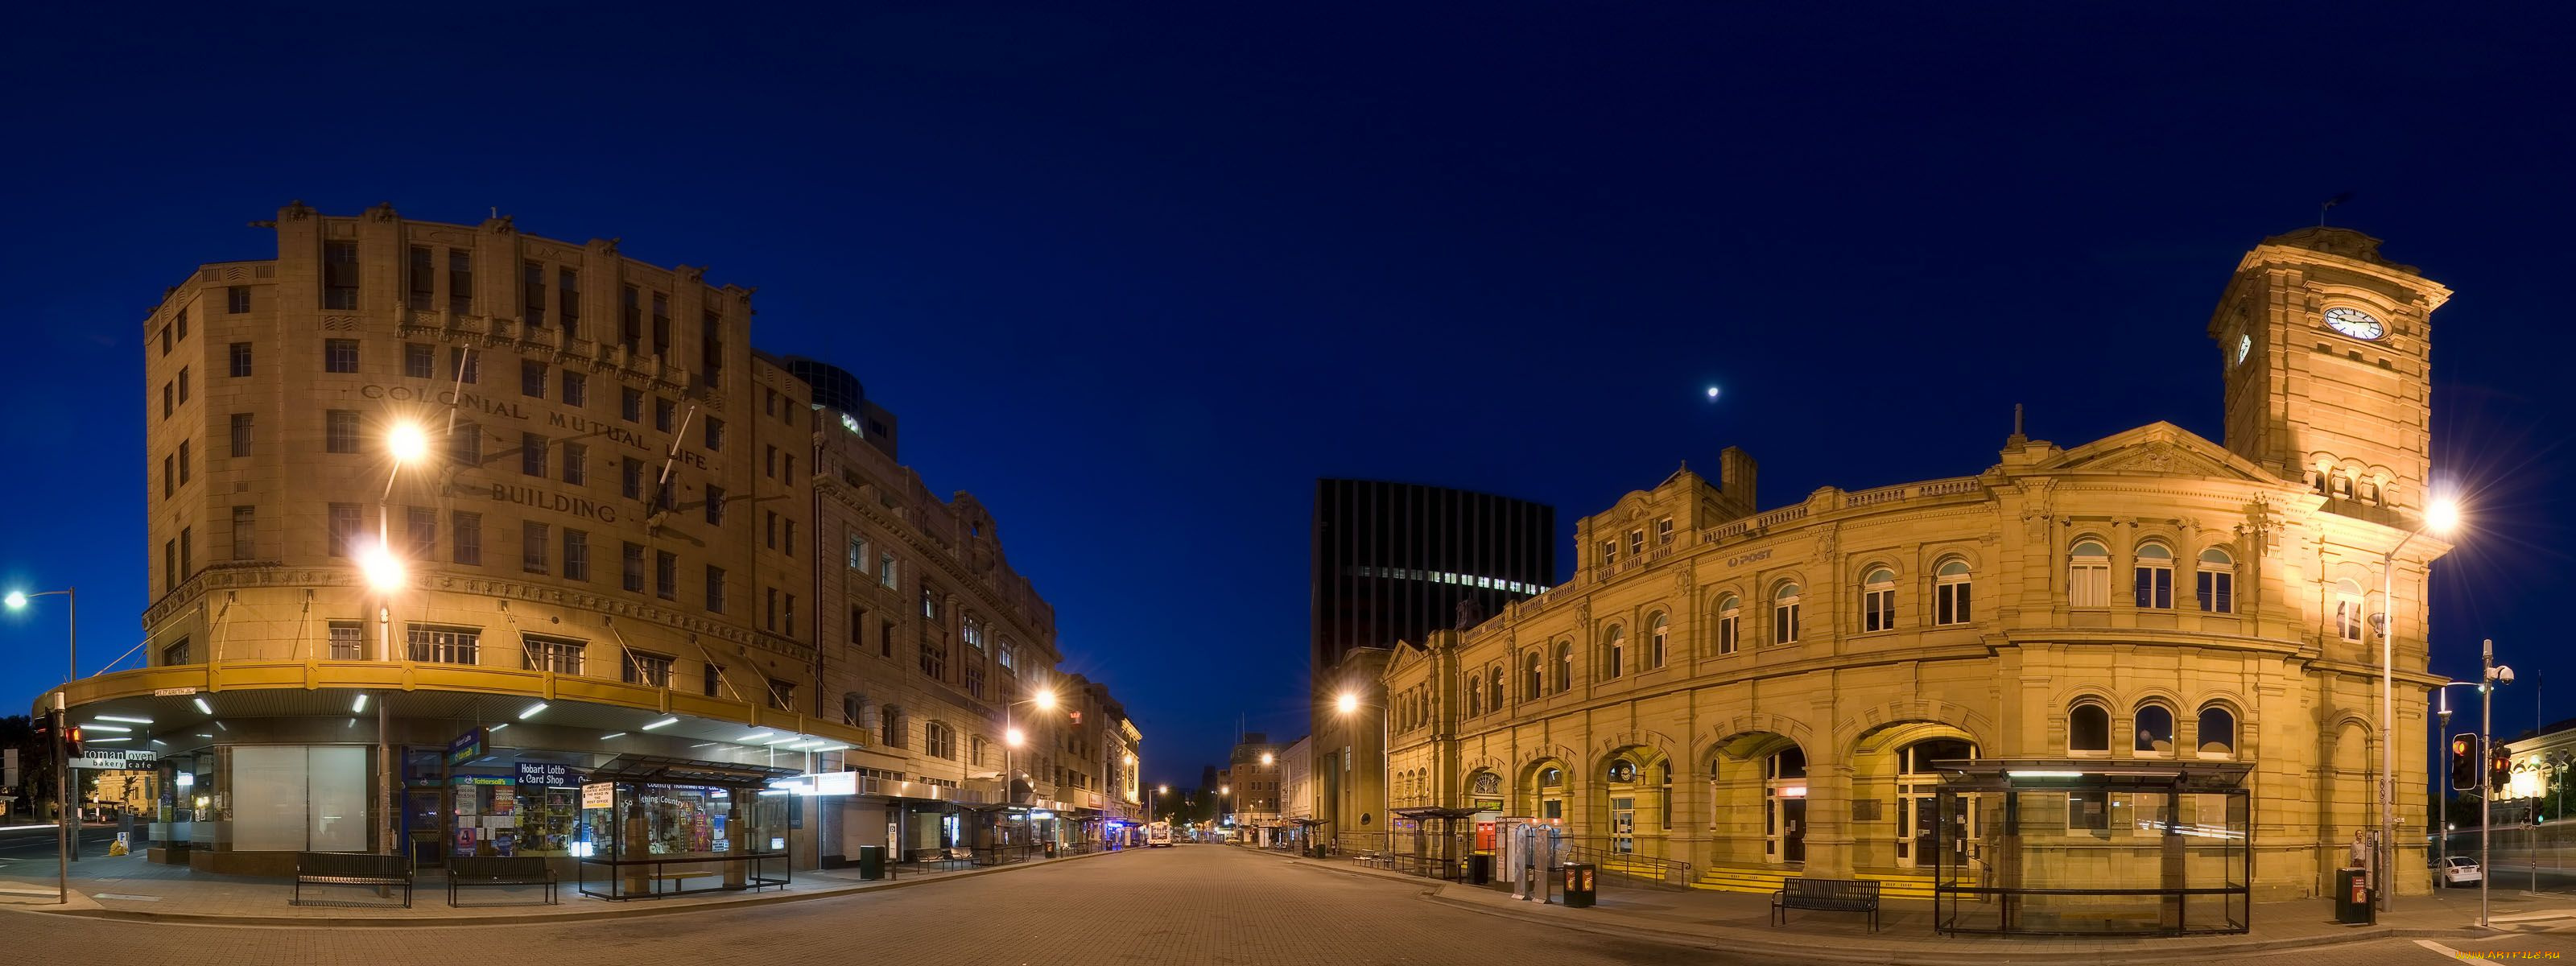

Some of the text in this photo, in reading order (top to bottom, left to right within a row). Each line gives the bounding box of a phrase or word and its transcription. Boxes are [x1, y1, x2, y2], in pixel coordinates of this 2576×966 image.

[361, 384, 708, 471] COLONIAL MUTUAL LIFE
[492, 482, 617, 523] BUILDING
[84, 750, 155, 761] roman oven
[93, 760, 124, 768] bakery
[521, 764, 565, 774] Hobart Lotto
[526, 774, 544, 784] Card
[547, 775, 564, 786] Shop
[660, 796, 684, 809] Country
